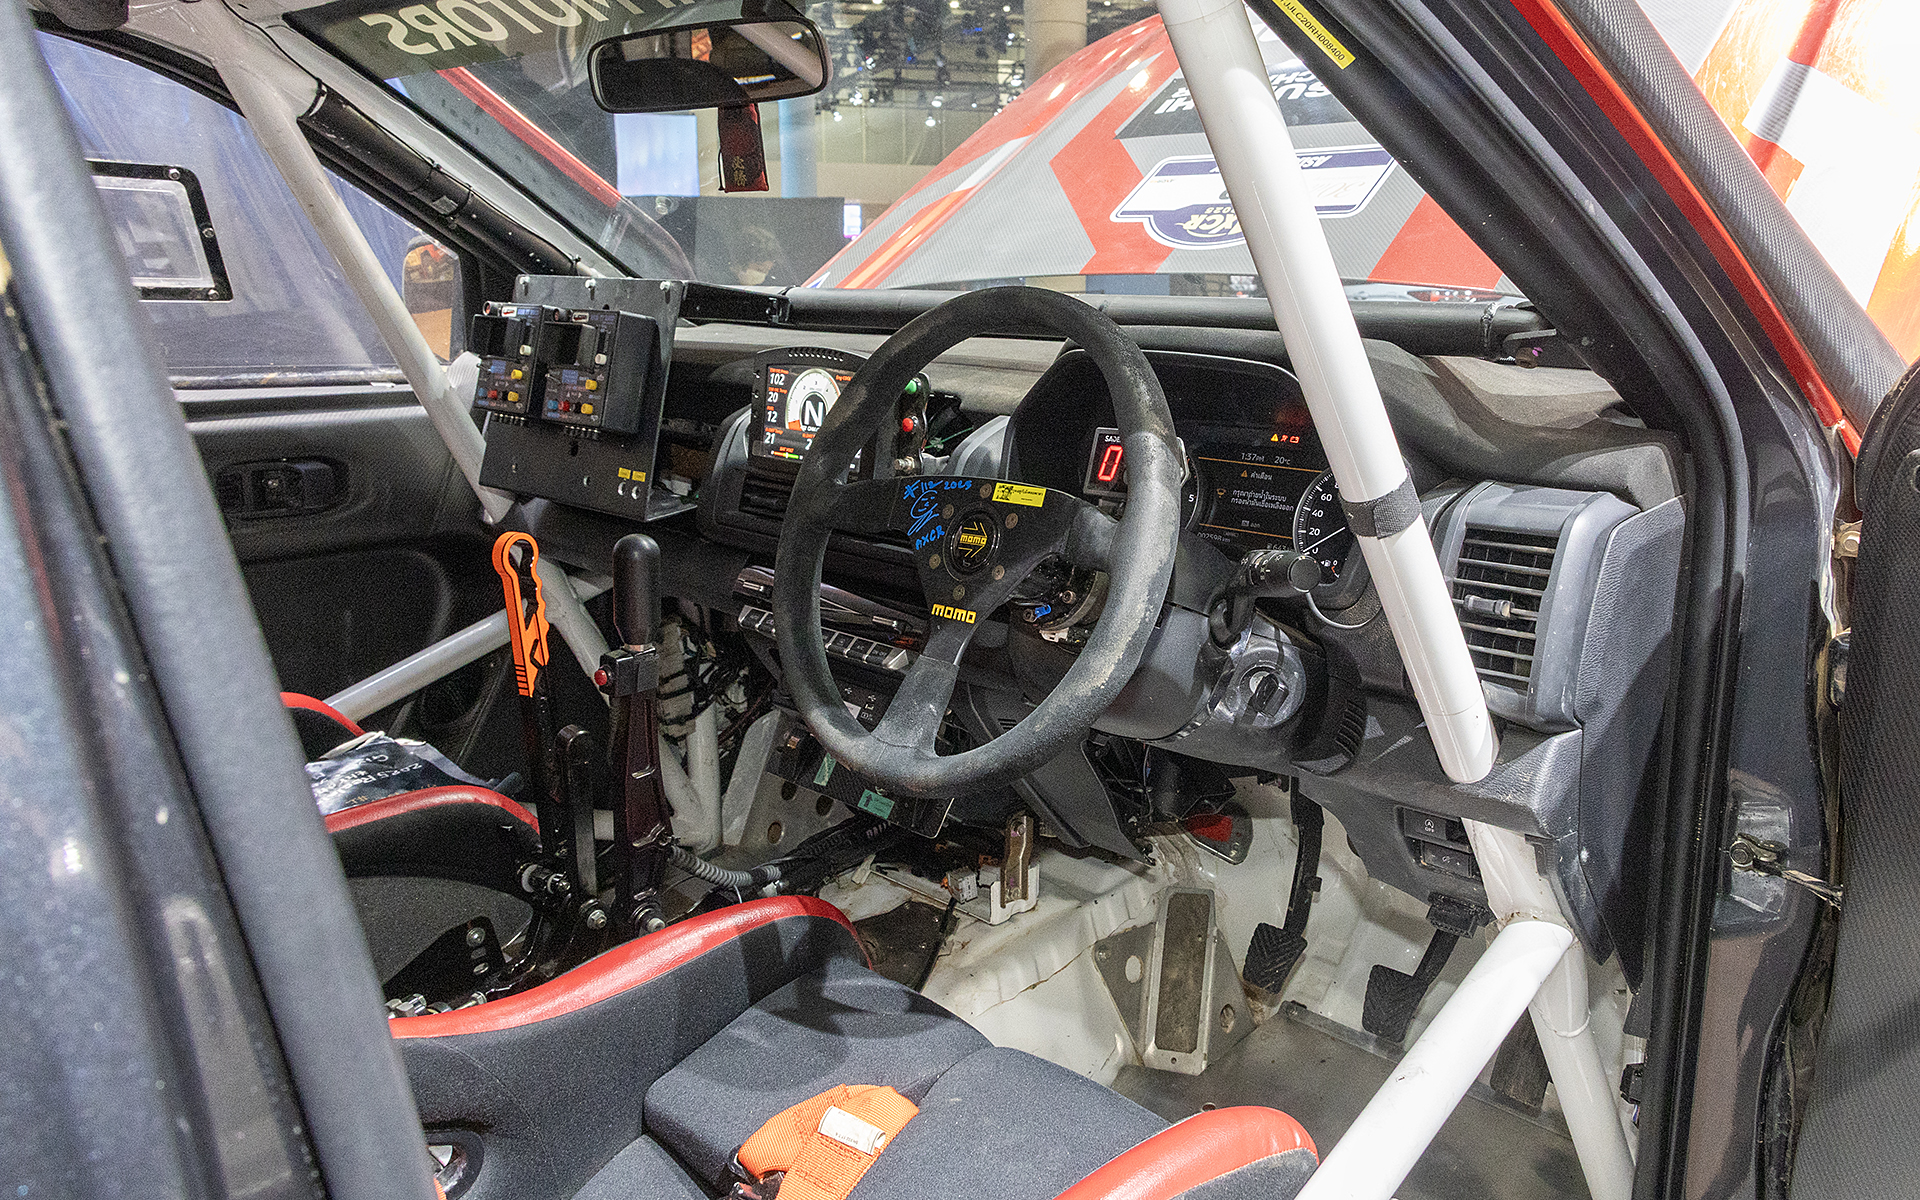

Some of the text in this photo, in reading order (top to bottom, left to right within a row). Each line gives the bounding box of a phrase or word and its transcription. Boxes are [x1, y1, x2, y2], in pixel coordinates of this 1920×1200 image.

[1281, 0, 1345, 61] JJLC20RH008400
[770, 373, 786, 386] 102
[768, 392, 779, 403] 20
[767, 411, 778, 423] 12
[804, 400, 824, 427] N
[765, 432, 776, 444] 21
[1097, 444, 1124, 482] 0
[1320, 493, 1333, 502] 60
[1311, 509, 1324, 518] 40
[1308, 527, 1320, 536] 20
